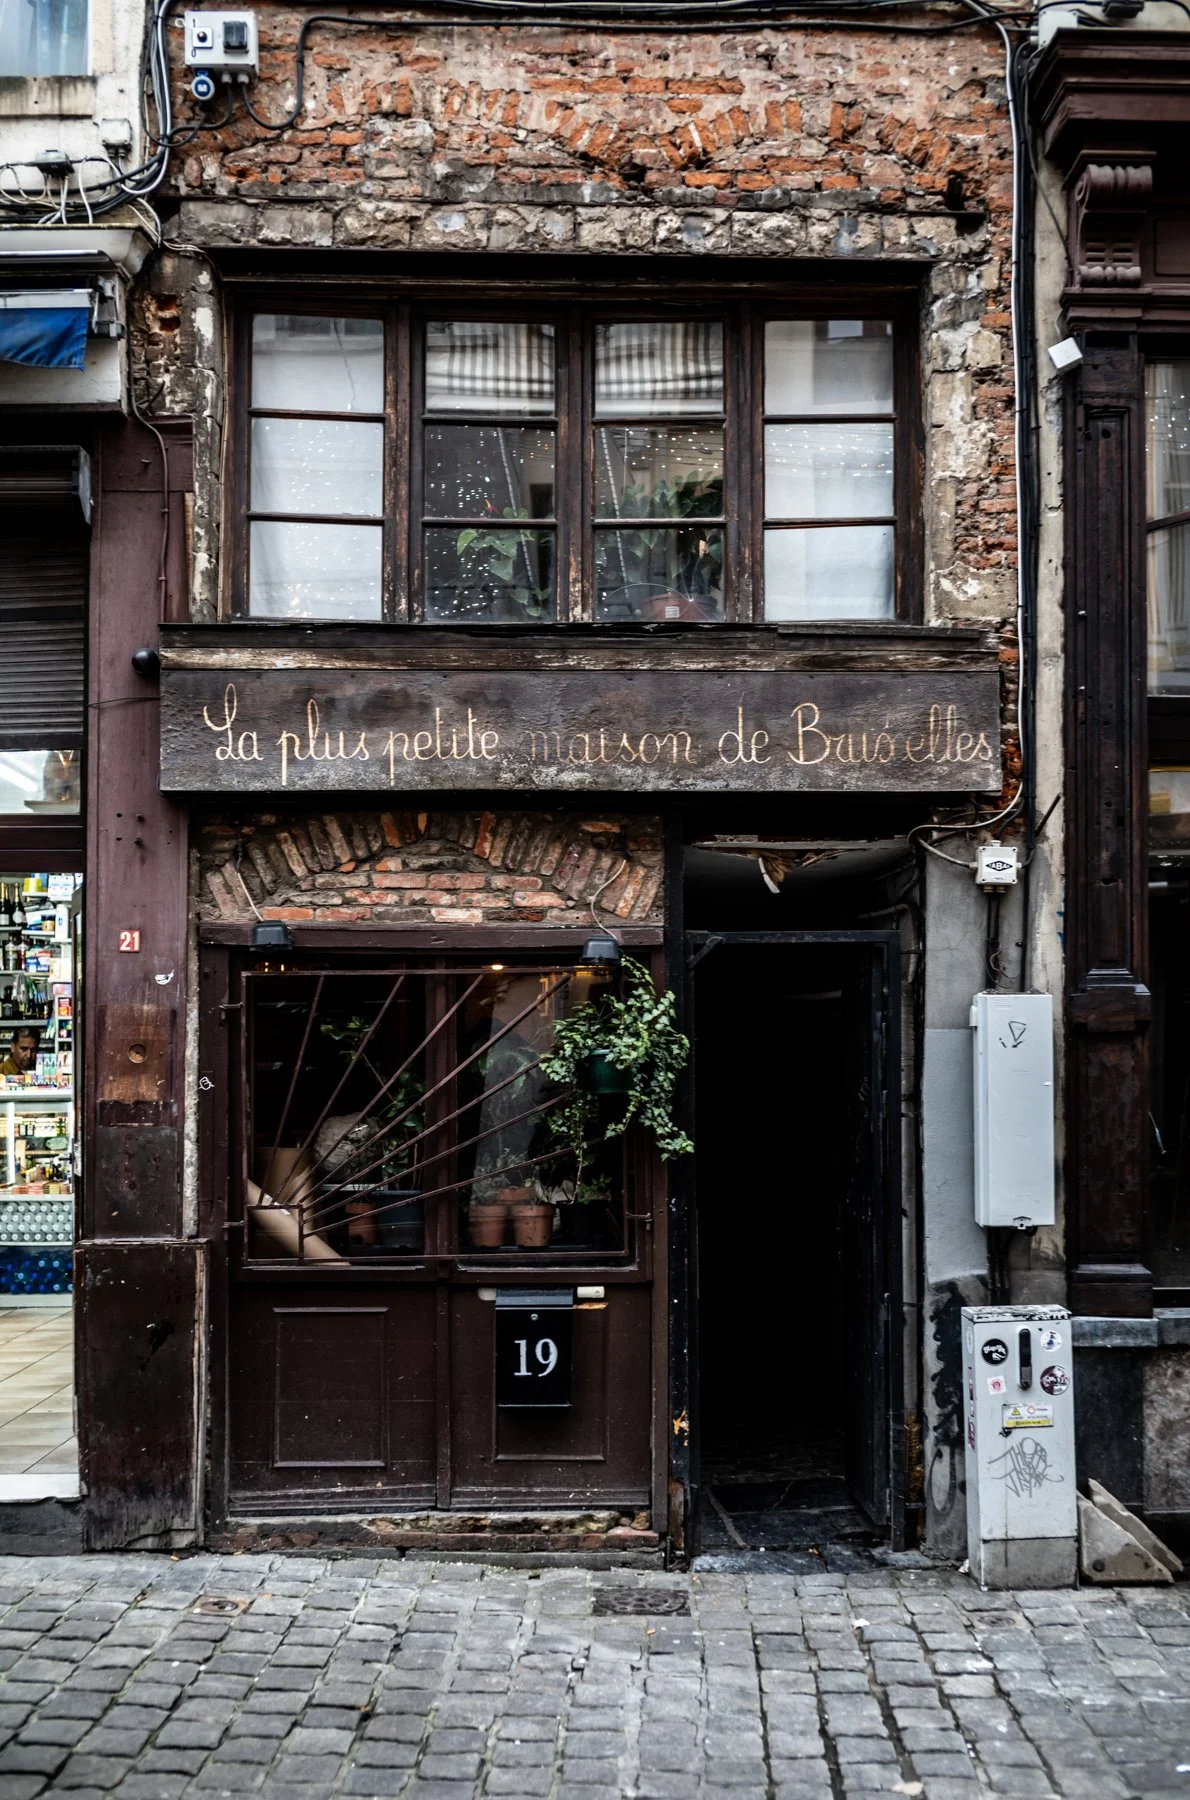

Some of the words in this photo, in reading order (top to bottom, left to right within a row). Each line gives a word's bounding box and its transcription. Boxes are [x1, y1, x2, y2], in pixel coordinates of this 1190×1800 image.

[203, 682, 265, 762] La
[275, 698, 370, 787] plus
[382, 706, 501, 787] petite
[518, 727, 698, 764] maison
[717, 703, 771, 765] de
[119, 931, 141, 951] 21
[513, 1338, 559, 1378] 19
